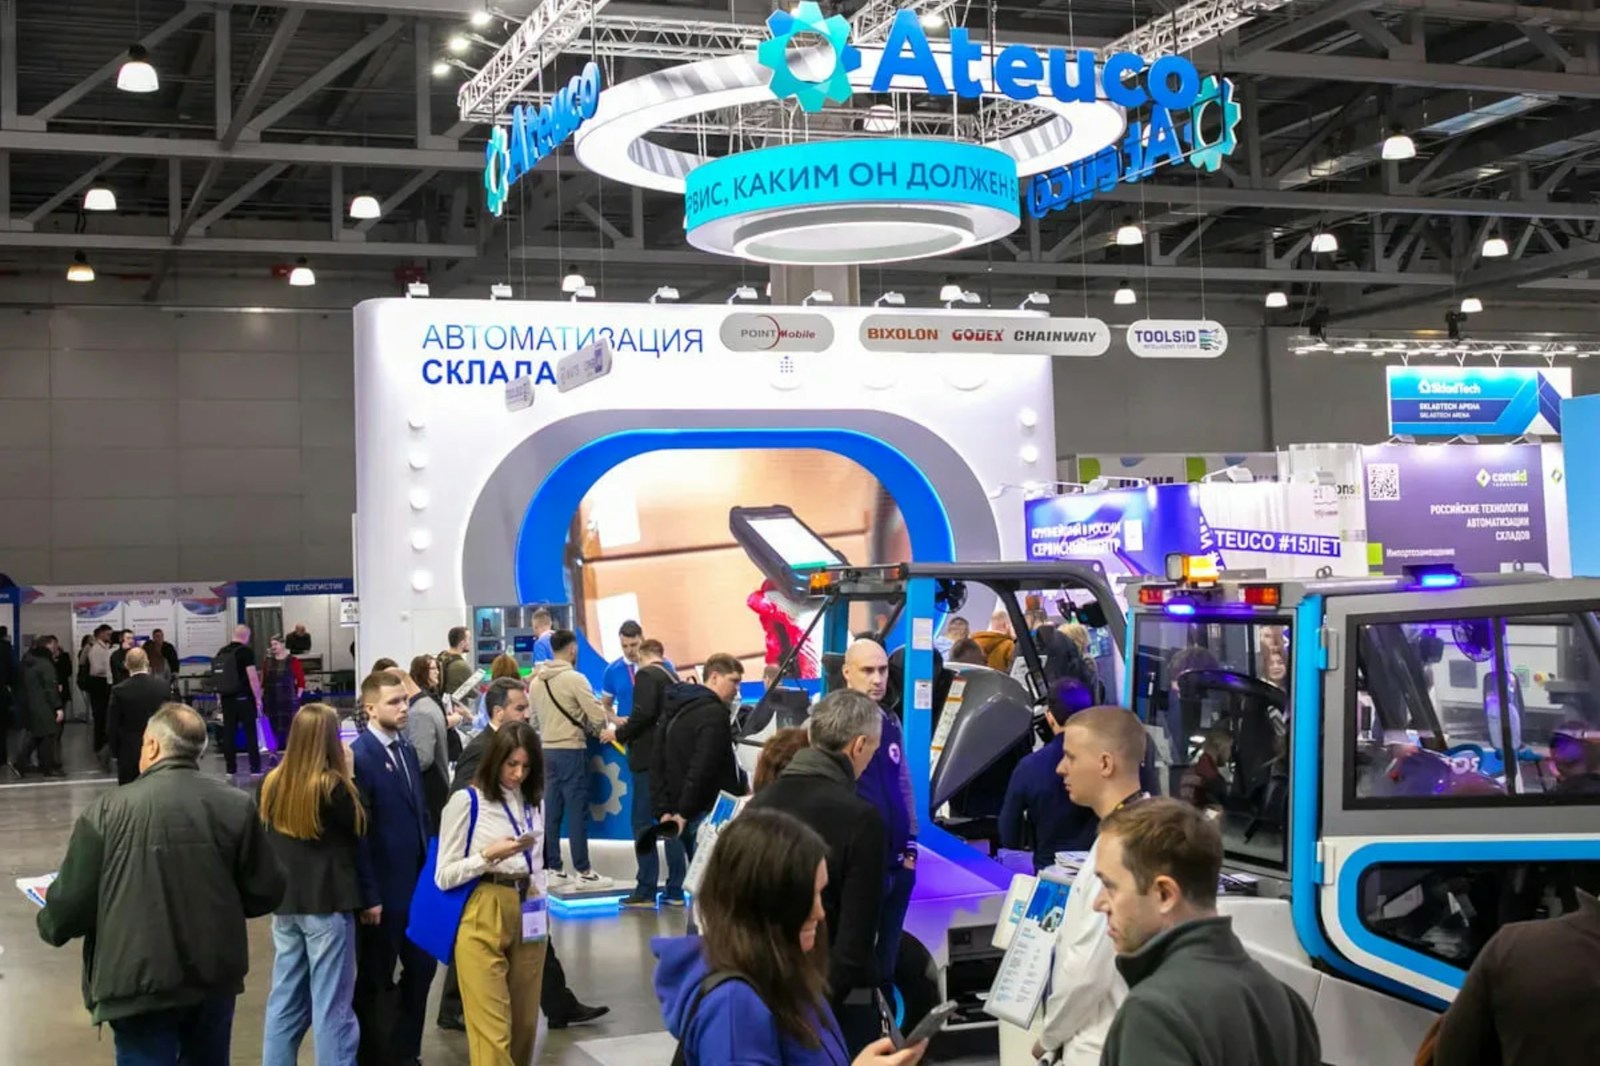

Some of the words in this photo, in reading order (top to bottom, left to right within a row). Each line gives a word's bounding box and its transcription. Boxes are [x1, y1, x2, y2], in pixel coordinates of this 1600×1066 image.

[871, 9, 1199, 110] Ateuco
[508, 62, 600, 185] Ateuco
[733, 164, 839, 200] КАКИМ
[849, 161, 897, 187] ОН
[906, 163, 1008, 198] ДОЛЖЕН
[741, 329, 776, 338] POINT
[778, 329, 816, 339] Mobile
[867, 328, 938, 340] BIXOLON
[952, 329, 1004, 341] GODEX
[1014, 330, 1097, 342] CHAINWAY
[1134, 330, 1196, 343] TOOLSiD
[422, 325, 703, 358] АВТОМАТИЗАЦИЯ
[1430, 502, 1480, 515] РОССИЙСКИЕ
[1481, 502, 1529, 513] ТЕХНОЛОГИИ
[1466, 517, 1530, 528] АВТОМАТИЗАЦИИ
[1495, 530, 1530, 541] СКЛАДОВ
